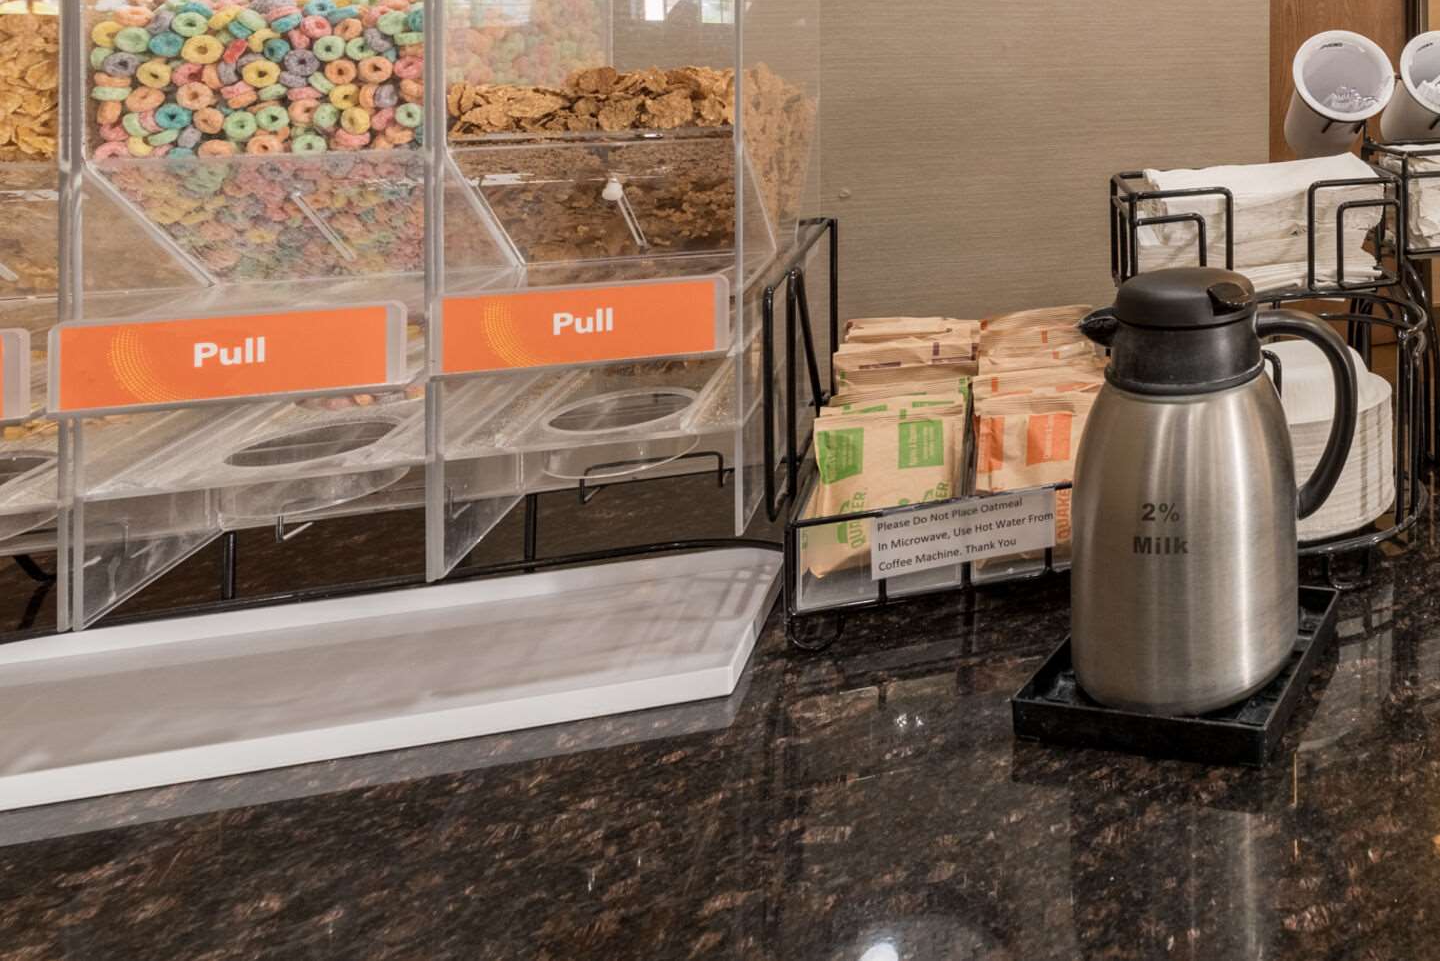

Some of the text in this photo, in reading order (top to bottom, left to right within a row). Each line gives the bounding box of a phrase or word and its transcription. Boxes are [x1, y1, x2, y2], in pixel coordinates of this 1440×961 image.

[553, 308, 613, 336] Pull
[193, 336, 265, 367] Pull
[850, 492, 866, 549] QUAER
[877, 498, 1022, 532] Please Do Not Place Oatmeal
[1056, 480, 1071, 540] QUAKE
[1142, 503, 1180, 522] 2%
[878, 512, 1053, 551] In Microwave, Use Hot Water From
[1133, 536, 1189, 555] Milk
[878, 538, 1016, 571] Coffee Machine. Thank You
